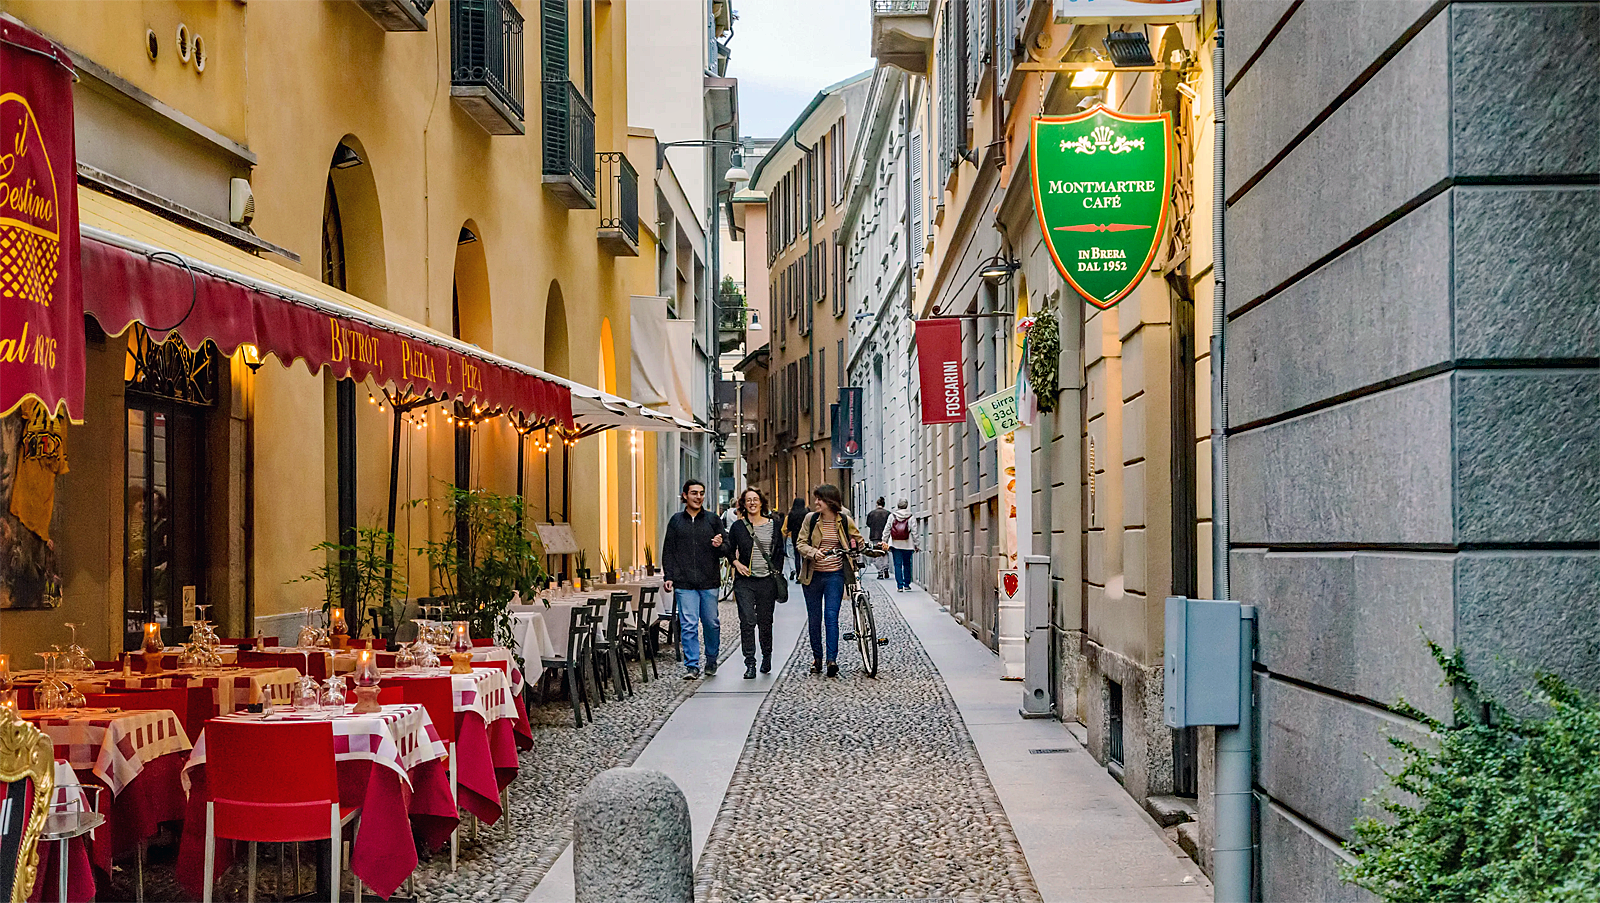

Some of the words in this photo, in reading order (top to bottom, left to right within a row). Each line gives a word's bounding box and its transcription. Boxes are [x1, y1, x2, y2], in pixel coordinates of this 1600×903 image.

[1048, 180, 1156, 194] MONTMARTRE
[1082, 194, 1122, 209] CAFÉ
[1090, 246, 1127, 260] BRERA
[1077, 261, 1101, 272] DAL
[1103, 261, 1128, 272] 1952
[32, 333, 57, 373] 1976
[943, 360, 961, 417] FOSCARINI
[991, 395, 1015, 410] Birra
[992, 407, 1015, 421] 33cl
